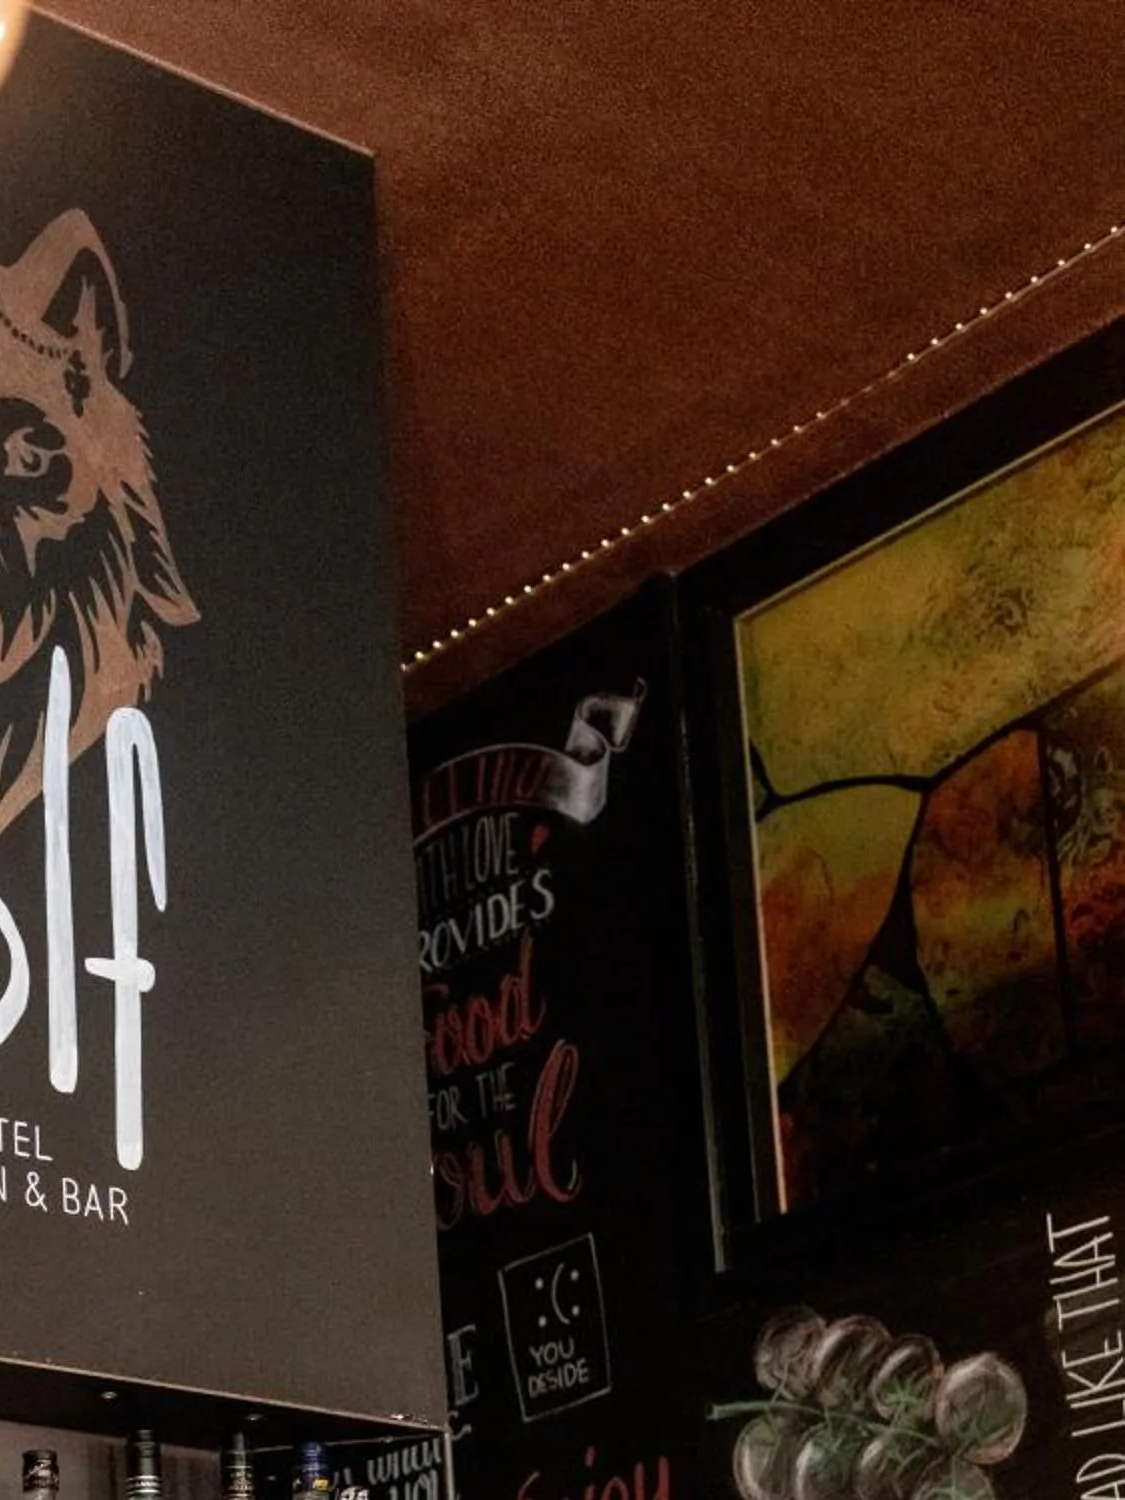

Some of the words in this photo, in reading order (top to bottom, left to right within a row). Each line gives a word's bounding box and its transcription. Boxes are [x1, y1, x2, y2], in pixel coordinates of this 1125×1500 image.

[461, 811, 522, 892] LOVE
[418, 868, 556, 973] ROVIDES
[423, 930, 548, 1076] ood
[475, 1061, 518, 1120] THE
[433, 1037, 585, 1232] oul
[24, 1170, 48, 1211] &
[61, 1176, 130, 1225] BAR
[1046, 1211, 1121, 1333] THAT
[527, 1358, 591, 1398] DESIDE
[528, 1336, 575, 1369] YOU
